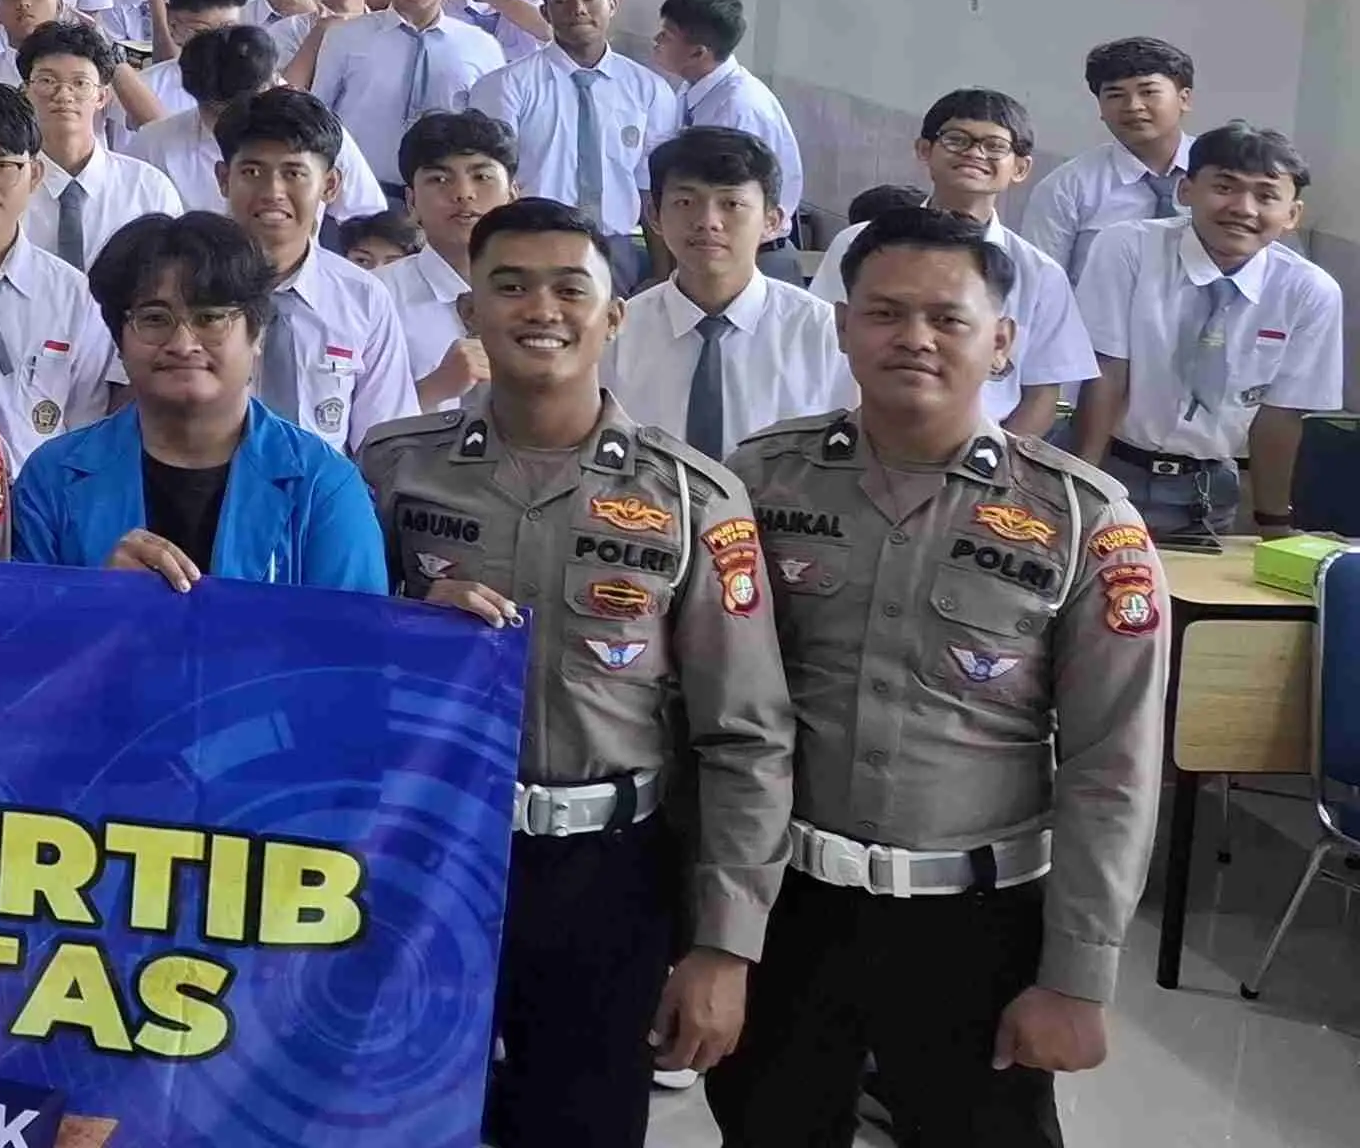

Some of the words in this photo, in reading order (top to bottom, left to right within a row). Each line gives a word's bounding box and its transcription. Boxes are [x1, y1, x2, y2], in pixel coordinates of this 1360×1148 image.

[402, 508, 480, 544] AGUNG
[755, 507, 844, 538] HAIKAL
[576, 537, 677, 573] POLRI
[951, 539, 1055, 591] POLRI
